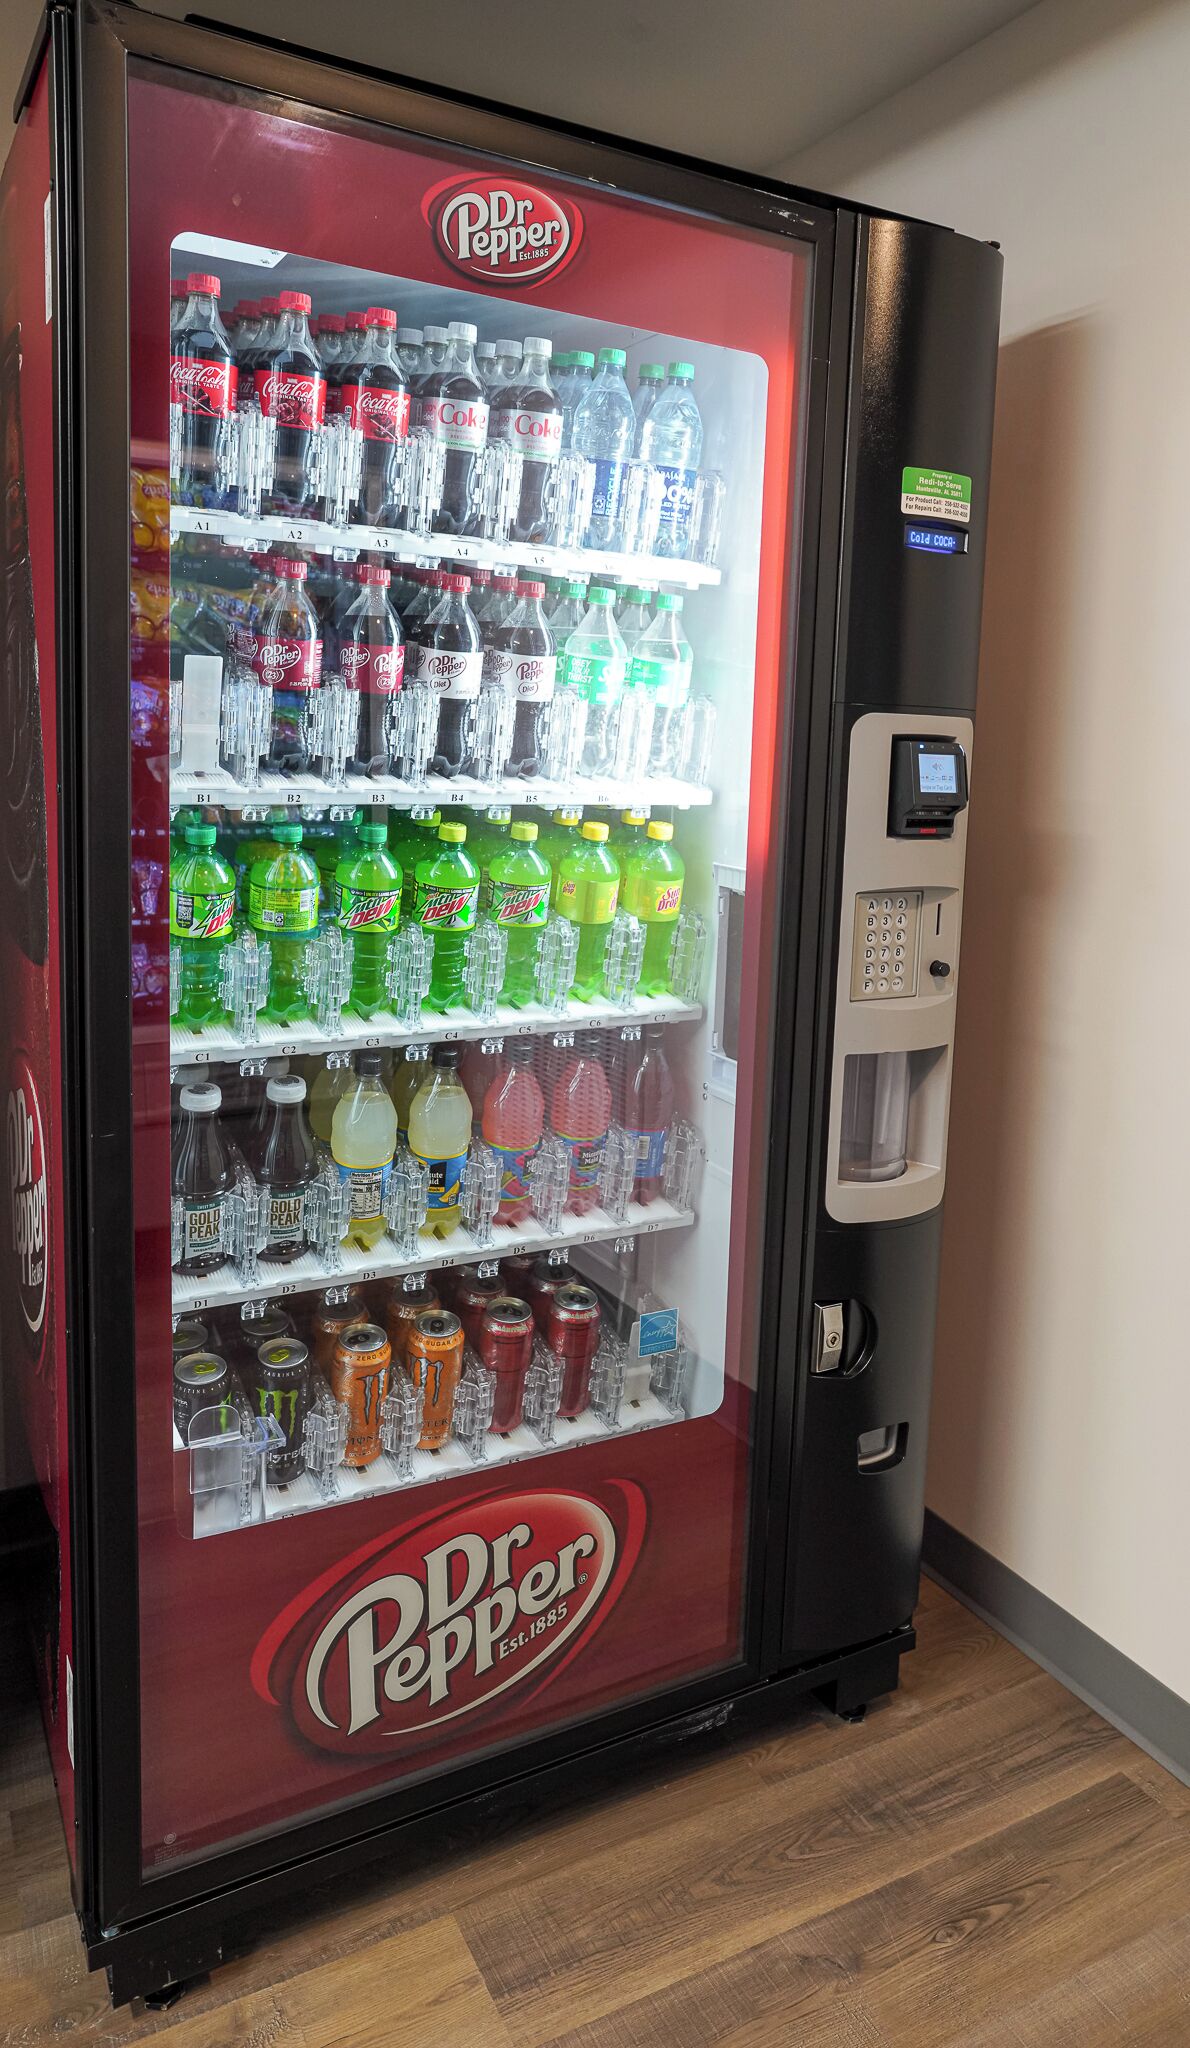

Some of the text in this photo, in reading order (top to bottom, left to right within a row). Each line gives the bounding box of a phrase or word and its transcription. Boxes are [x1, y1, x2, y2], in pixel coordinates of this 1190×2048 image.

[488, 190, 534, 229] Dr
[442, 192, 562, 266] Pepper
[203, 382, 220, 390] TASTE
[438, 403, 485, 429] Coke
[515, 414, 560, 439] Coke
[915, 504, 932, 512] Repairs
[194, 521, 210, 531] A1
[287, 530, 303, 540] A2
[910, 531, 931, 545] Cold
[374, 538, 389, 548] A3
[455, 548, 468, 557] A4
[273, 644, 289, 654] Dr
[348, 646, 360, 656] Dr
[261, 645, 299, 666] Pepper
[340, 647, 368, 666] Pepper
[441, 655, 456, 666] Dr
[428, 656, 465, 676] Pepper
[531, 660, 544, 671] Dr
[516, 662, 545, 681] Pepp
[522, 685, 535, 693] Diet
[197, 794, 211, 803] B1
[287, 794, 301, 803] B2
[372, 794, 385, 803] B3
[450, 794, 464, 802] B4
[525, 795, 538, 803] B5
[662, 887, 681, 900] Sun
[656, 897, 679, 912] Drop
[869, 901, 875, 910] A
[884, 901, 889, 910] 1
[898, 900, 904, 909] 2
[867, 917, 874, 926] B
[883, 916, 888, 926] 3
[897, 916, 903, 925] 4
[866, 933, 873, 943] C
[882, 932, 887, 942] 5
[896, 932, 902, 941] 6
[866, 949, 872, 958] D
[881, 948, 887, 957] 7
[895, 948, 901, 956] 8
[865, 965, 871, 974] E
[880, 964, 886, 974] 9
[895, 963, 900, 972] 0
[864, 981, 870, 991] F
[654, 1014, 666, 1022] C7
[589, 1019, 602, 1028] C6
[518, 1025, 531, 1034] C5
[445, 1031, 458, 1040] C4
[366, 1038, 380, 1047] C3
[282, 1045, 296, 1054] C2
[195, 1052, 211, 1062] C1
[17, 1087, 34, 1186] Dr
[585, 1156, 599, 1164] Maid
[270, 1199, 301, 1213] GOLD
[189, 1209, 220, 1226] GOLD
[270, 1211, 301, 1226] PEAK
[189, 1221, 220, 1239] PEAK
[647, 1224, 659, 1232] D7
[513, 1245, 526, 1254] D5
[441, 1258, 455, 1267] D4
[363, 1271, 377, 1280] D3
[282, 1285, 296, 1294] D2
[194, 1299, 208, 1309] D1
[263, 1369, 296, 1378] TAURINE
[422, 1522, 533, 1631] Dr
[305, 1533, 596, 1738] Pepper
